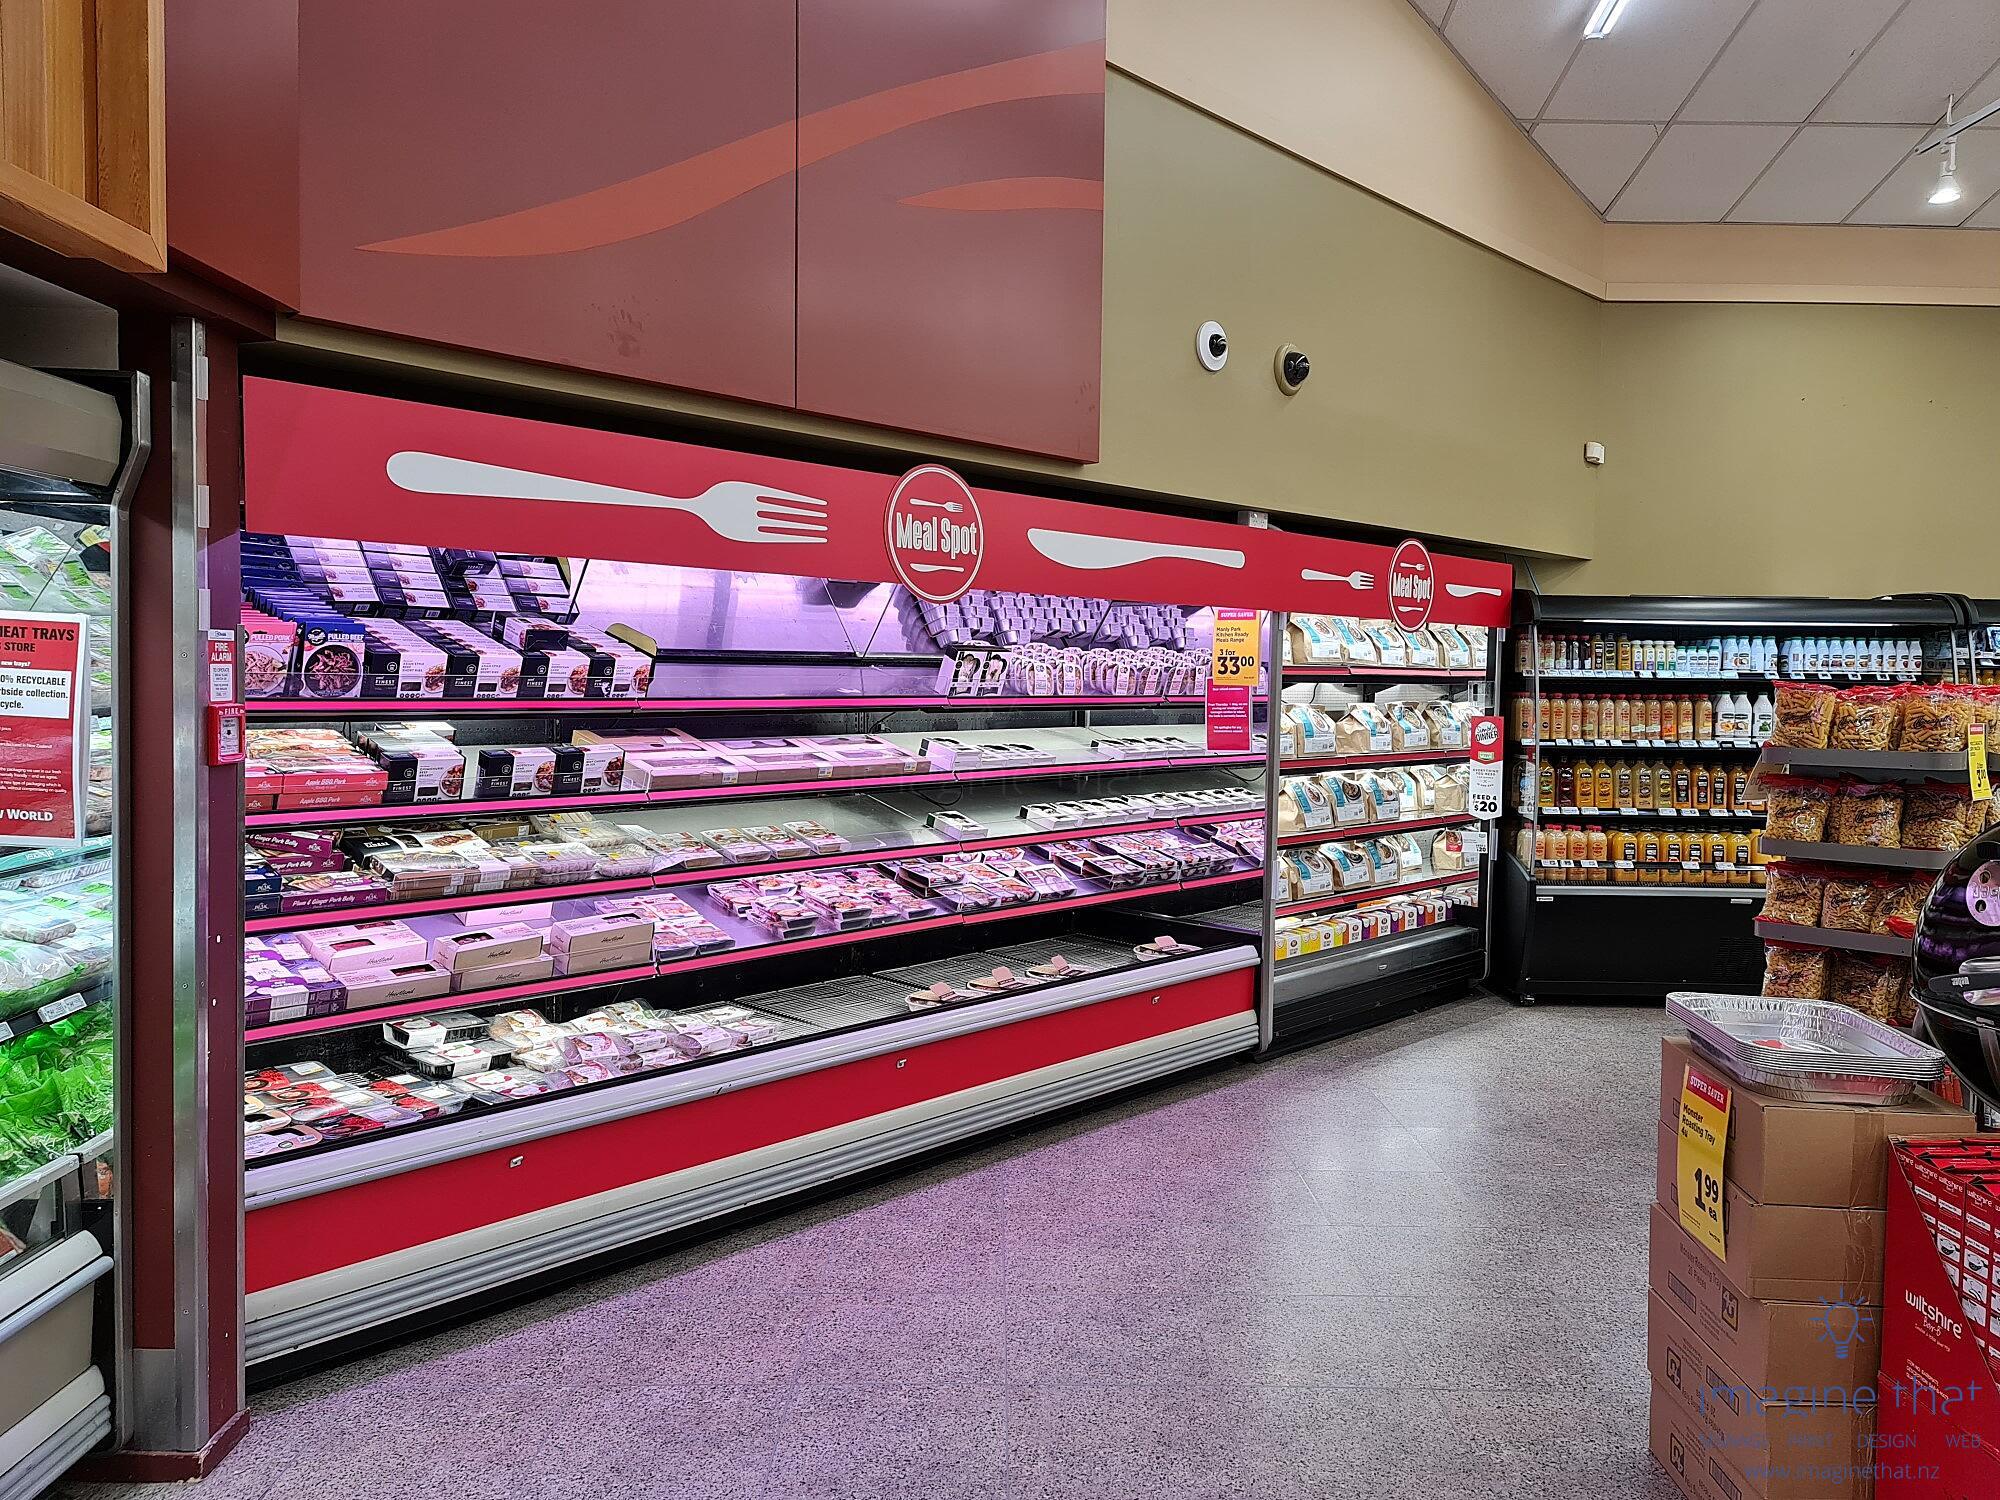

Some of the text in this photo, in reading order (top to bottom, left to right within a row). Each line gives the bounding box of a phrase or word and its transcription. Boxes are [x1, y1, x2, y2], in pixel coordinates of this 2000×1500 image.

[896, 512, 977, 560] Meal Spot
[1392, 572, 1431, 603] Meal Spot
[0, 626, 75, 641] EAT TRAYS
[250, 634, 290, 642] PULLED PORK
[327, 633, 349, 642] PULLED
[350, 634, 364, 642] BEEF
[4, 642, 36, 652] STORE
[214, 642, 229, 652] FIRE
[211, 652, 232, 662] ALARM
[16, 675, 66, 686] RECYCLABLE
[26, 689, 68, 699] collection.
[1475, 732, 1498, 742] DINNER
[305, 779, 320, 787] Apple
[300, 797, 315, 805] Apple
[1474, 801, 1498, 813] $20
[254, 834, 298, 848] Ginger Pork Belly
[300, 860, 313, 868] Belly
[312, 898, 329, 906] Ginger
[342, 895, 356, 903] Belly
[1689, 1075, 1724, 1105] SUPER SAVER
[1683, 1102, 1704, 1123] Monster
[1681, 1115, 1716, 1146] Roasting Tray
[1914, 1163, 1938, 1180] wiltshire
[1938, 1175, 1963, 1193] wiltshire
[1966, 1189, 1993, 1207] wiltshire
[1708, 1206, 1718, 1222] ea
[1905, 1289, 1961, 1340] wiltshire
